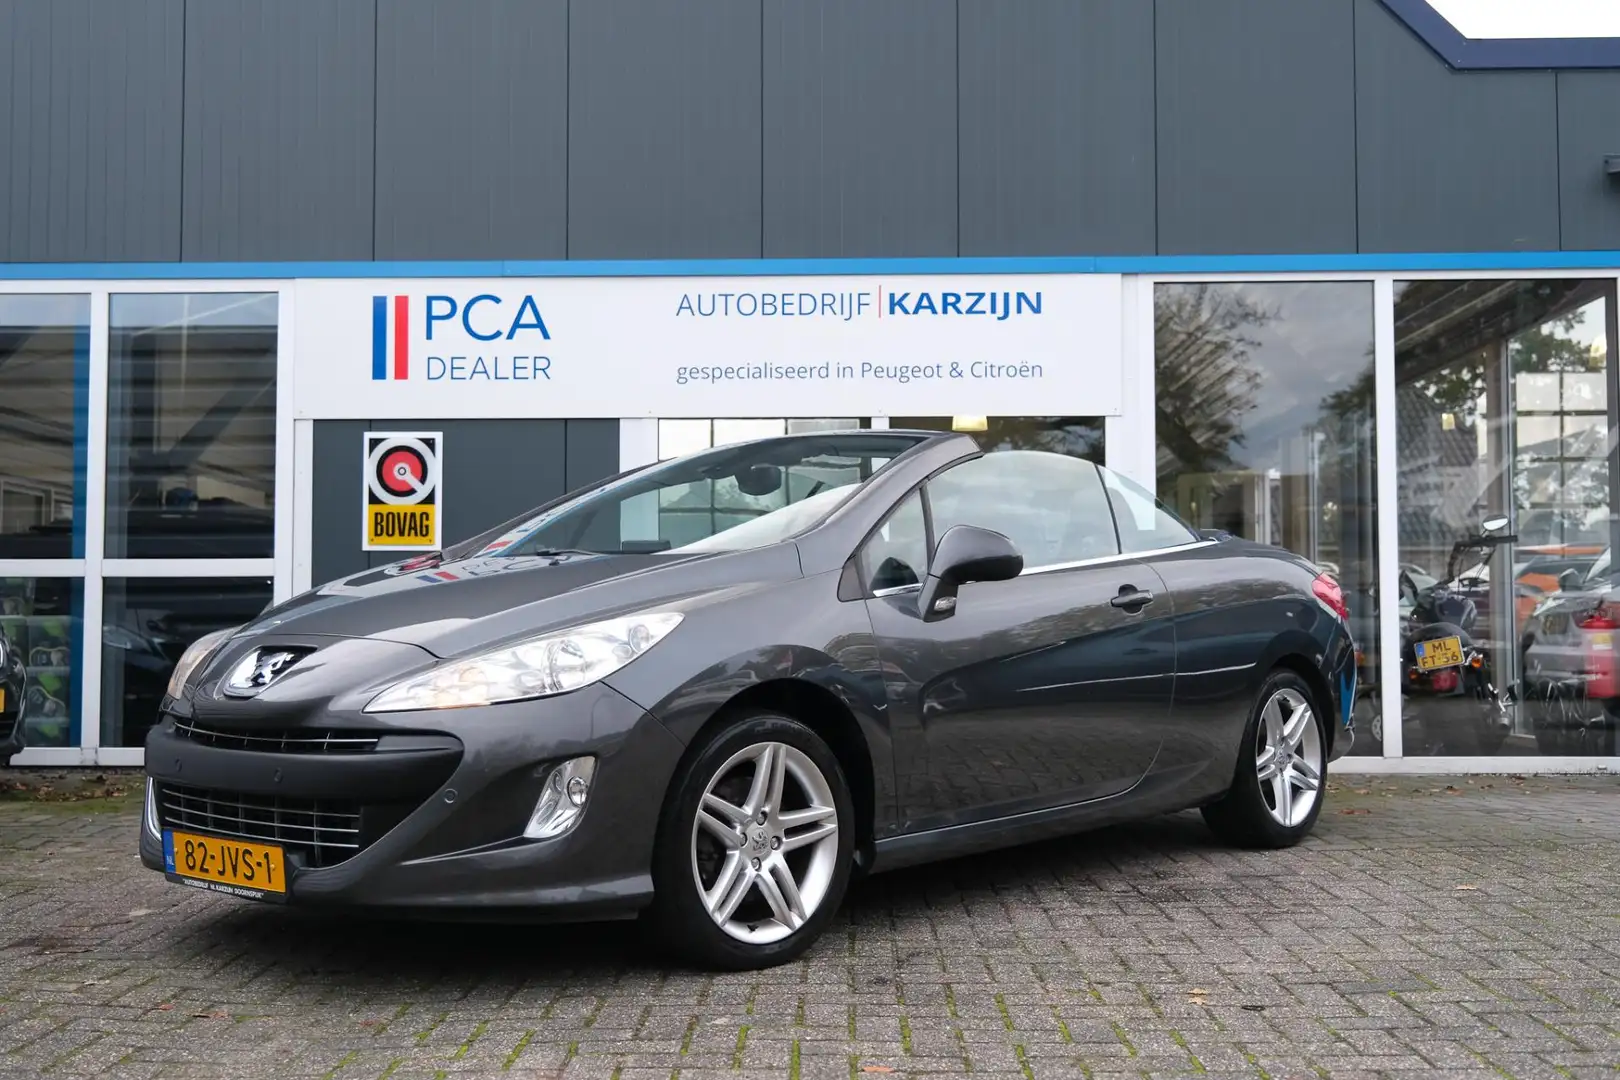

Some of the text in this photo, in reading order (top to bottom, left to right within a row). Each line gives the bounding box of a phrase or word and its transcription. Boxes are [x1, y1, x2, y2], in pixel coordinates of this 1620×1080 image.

[426, 293, 552, 342] PCA
[676, 291, 1043, 321] AUTOBEDRIJF KARZIJN
[427, 355, 552, 381] DEALER
[676, 360, 1043, 384] gespecialiseerd in Peugeot & Citroën
[374, 511, 430, 538] BOVAG
[1431, 641, 1452, 653] ML
[184, 840, 271, 884] 82-JVS-1
